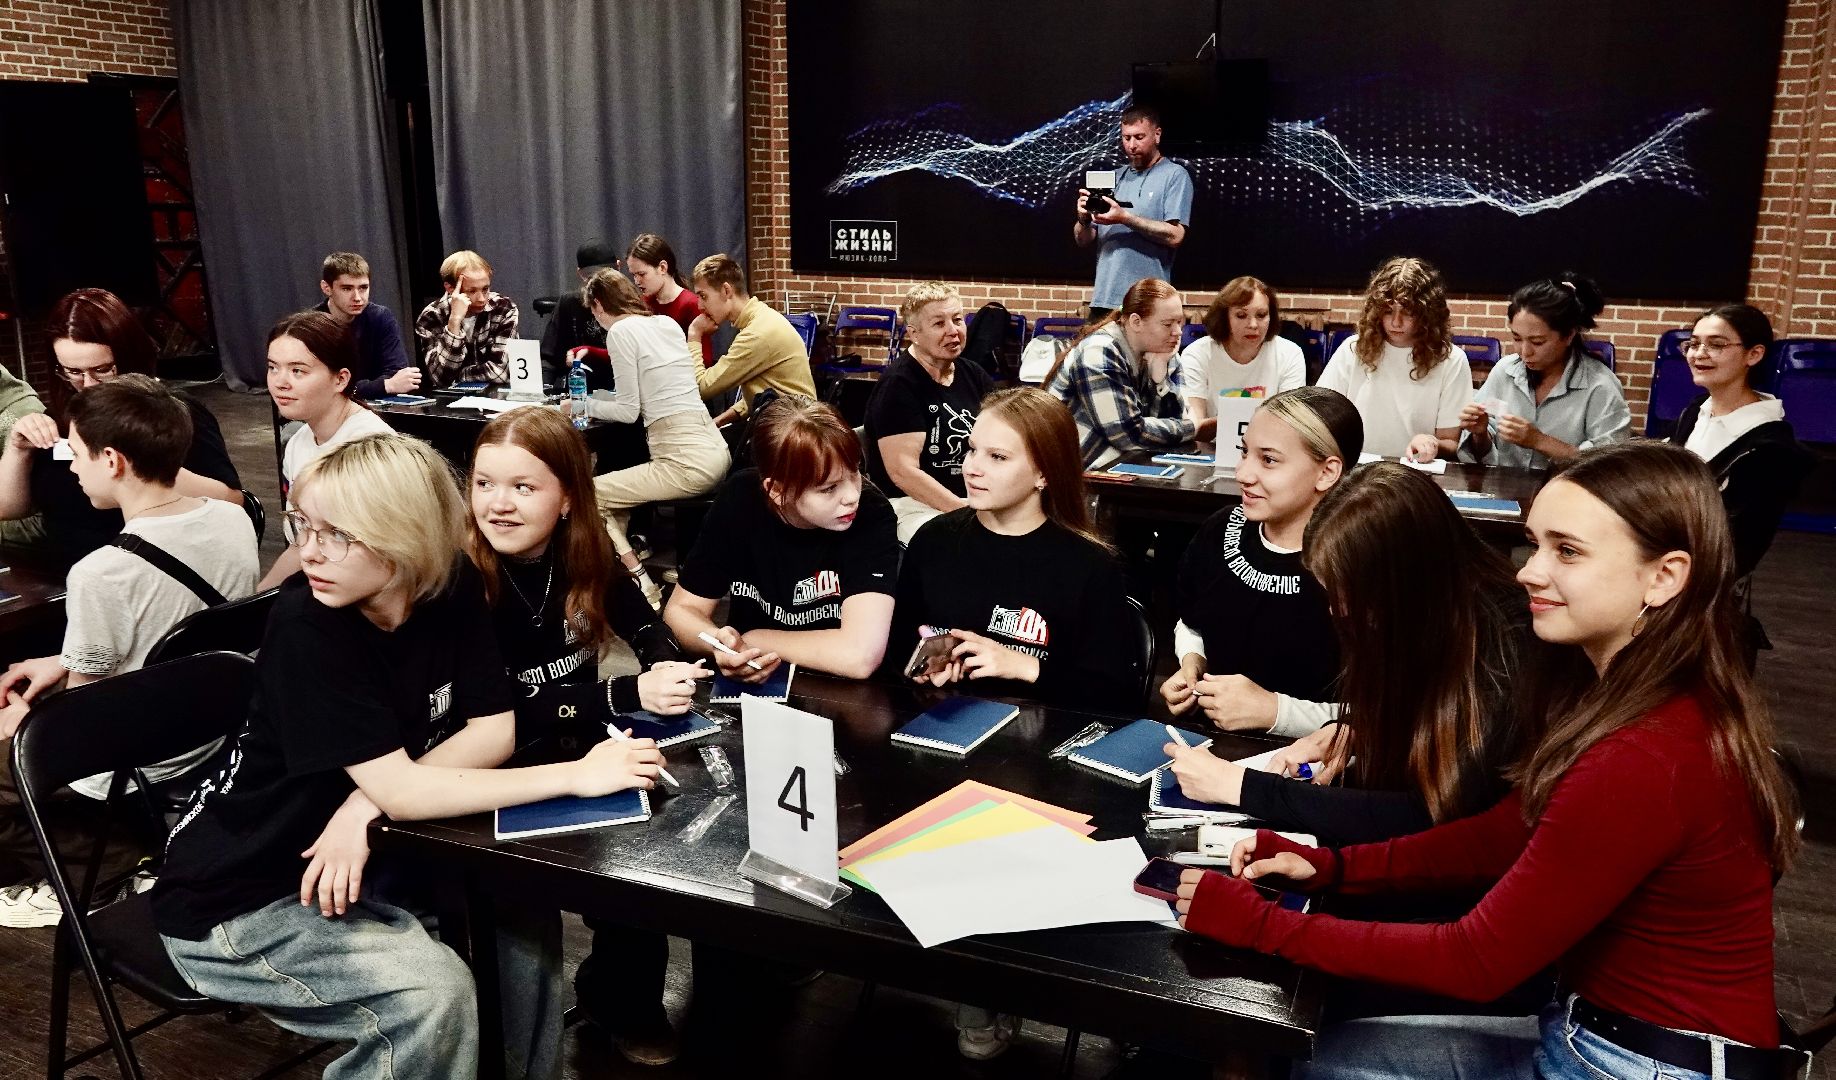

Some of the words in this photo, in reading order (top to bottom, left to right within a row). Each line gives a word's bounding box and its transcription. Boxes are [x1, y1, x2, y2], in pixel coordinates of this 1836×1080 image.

[837, 228, 891, 239] СТИЛЬ
[835, 240, 892, 251] ЖИЗНИ
[516, 358, 529, 380] 3
[777, 765, 815, 832] 4
